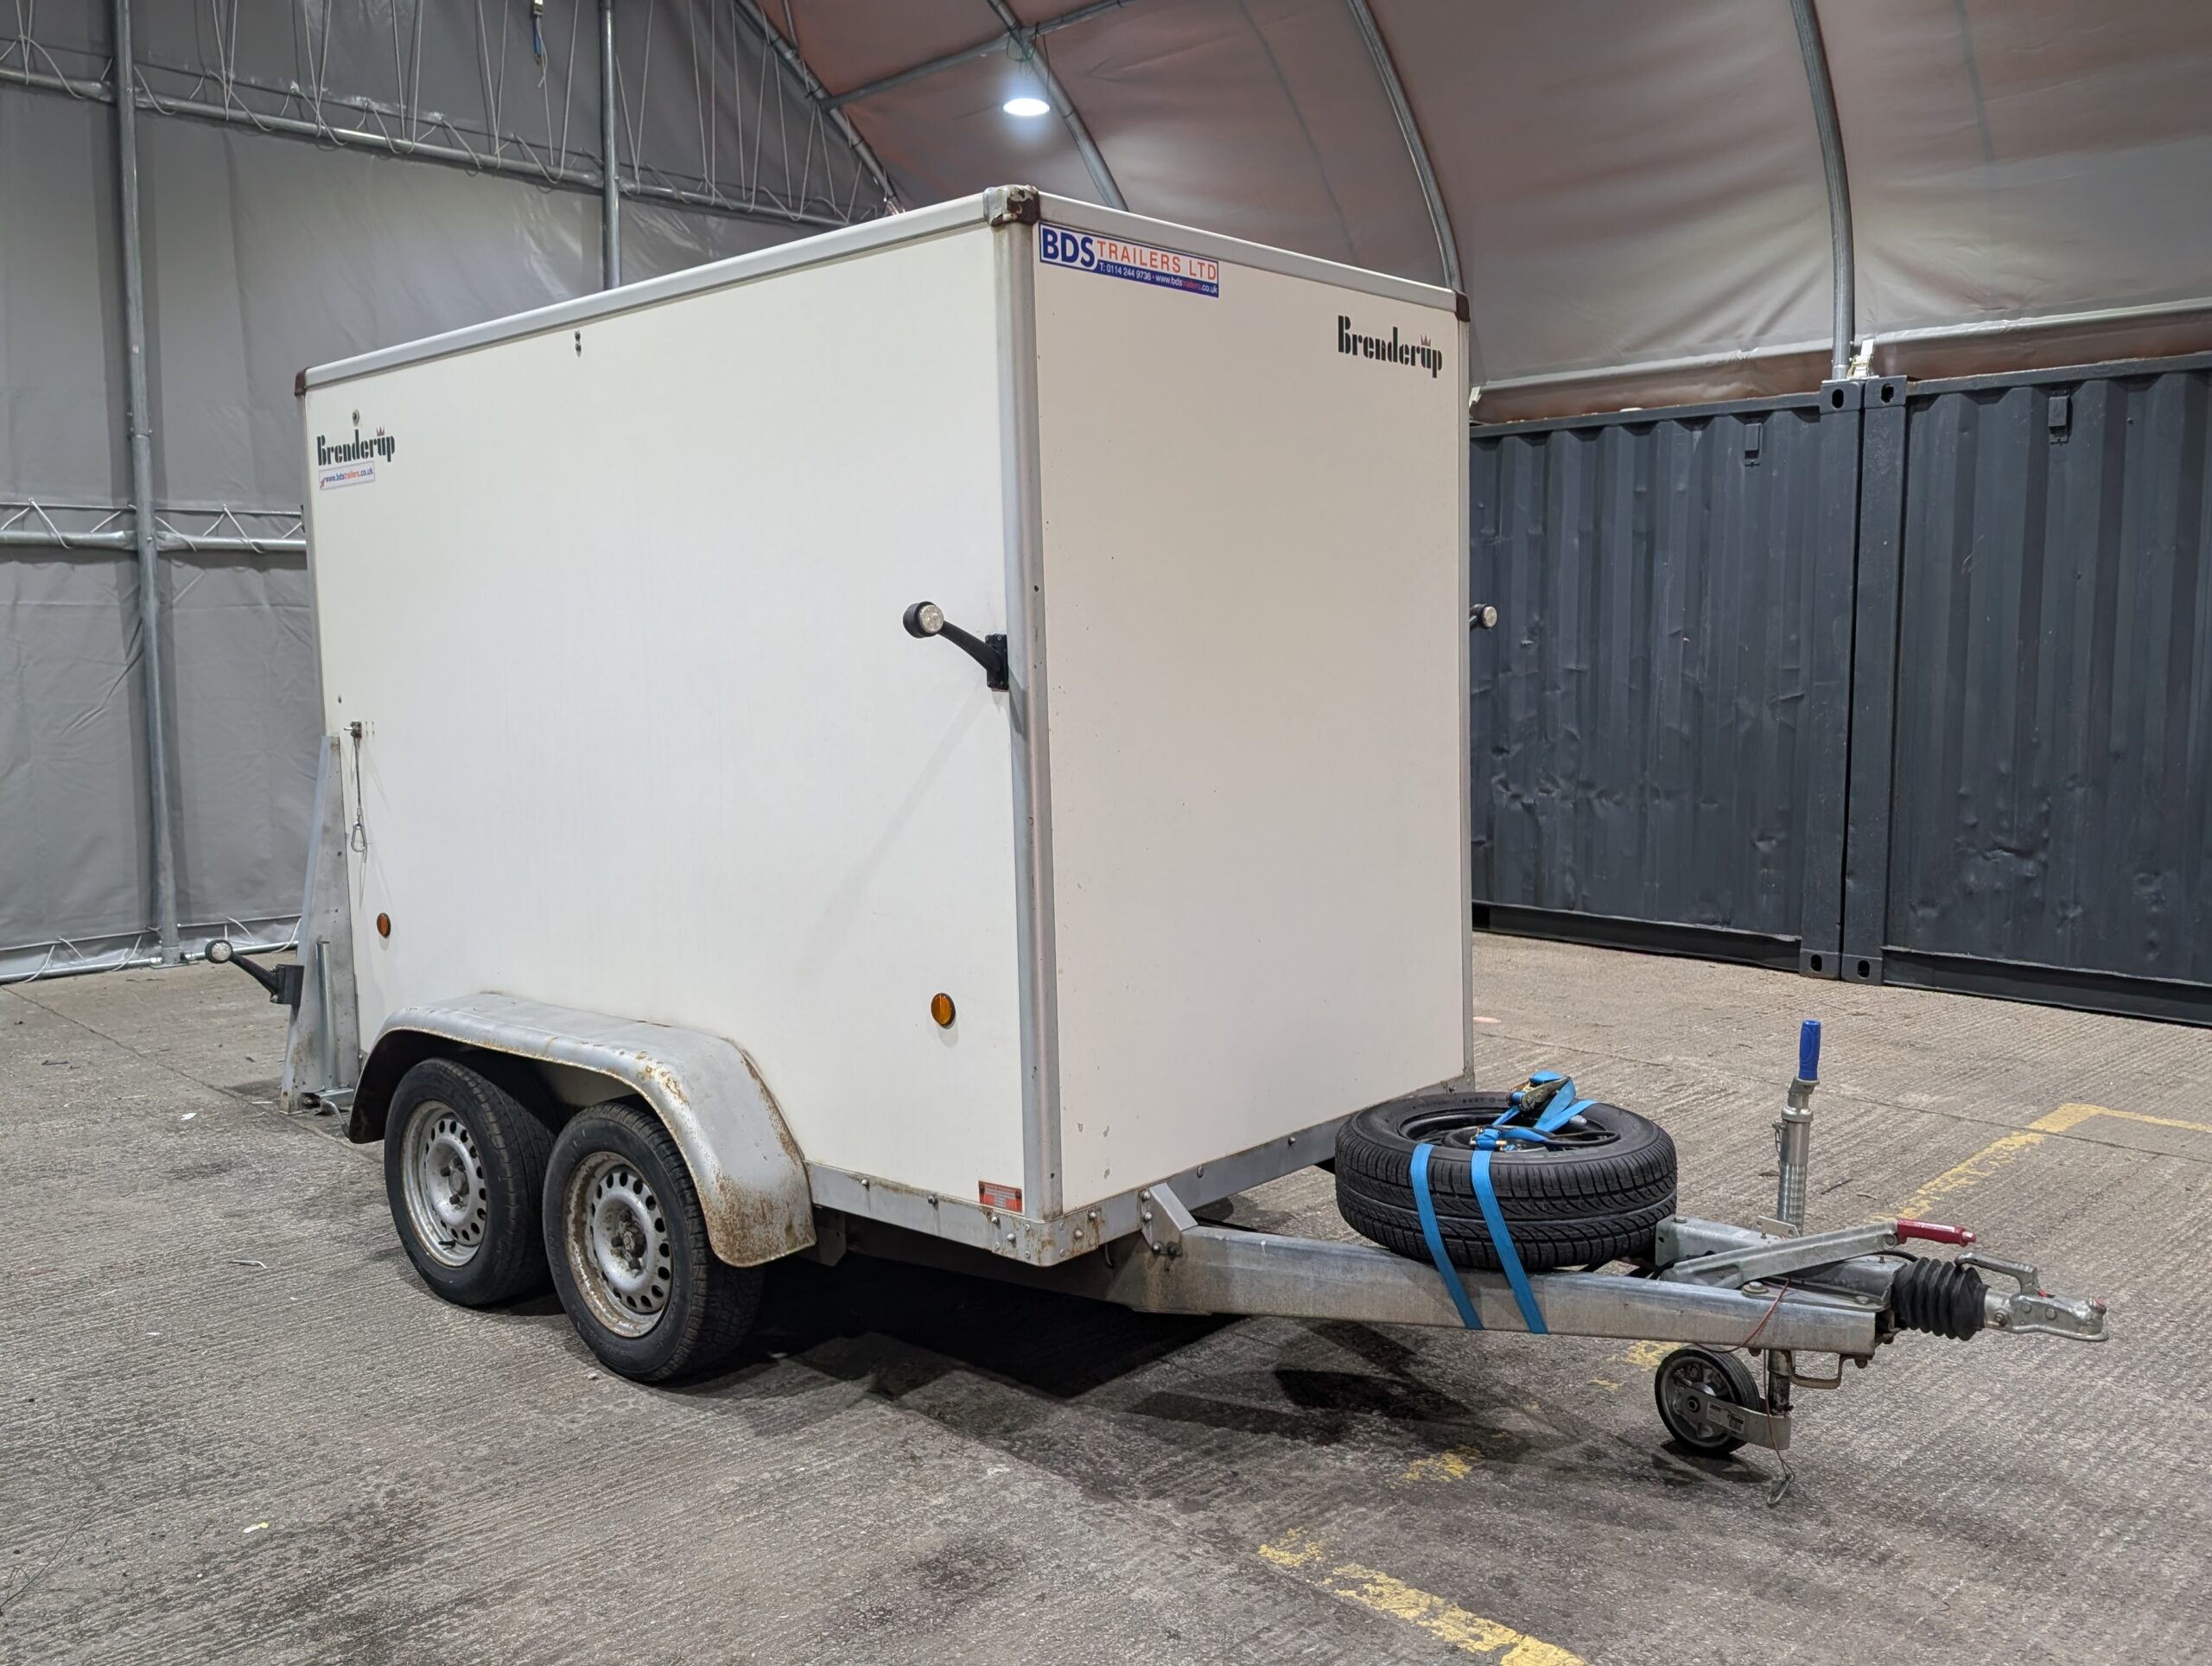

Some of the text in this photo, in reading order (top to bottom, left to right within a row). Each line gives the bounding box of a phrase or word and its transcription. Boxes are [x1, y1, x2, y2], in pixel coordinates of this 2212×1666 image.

[1042, 226, 1217, 280] BDS TRAILERS LTD
[1106, 264, 1122, 276] 0114
[1123, 267, 1135, 277] 244
[1338, 315, 1442, 378] Brenderup
[316, 429, 396, 467] Brenderup
